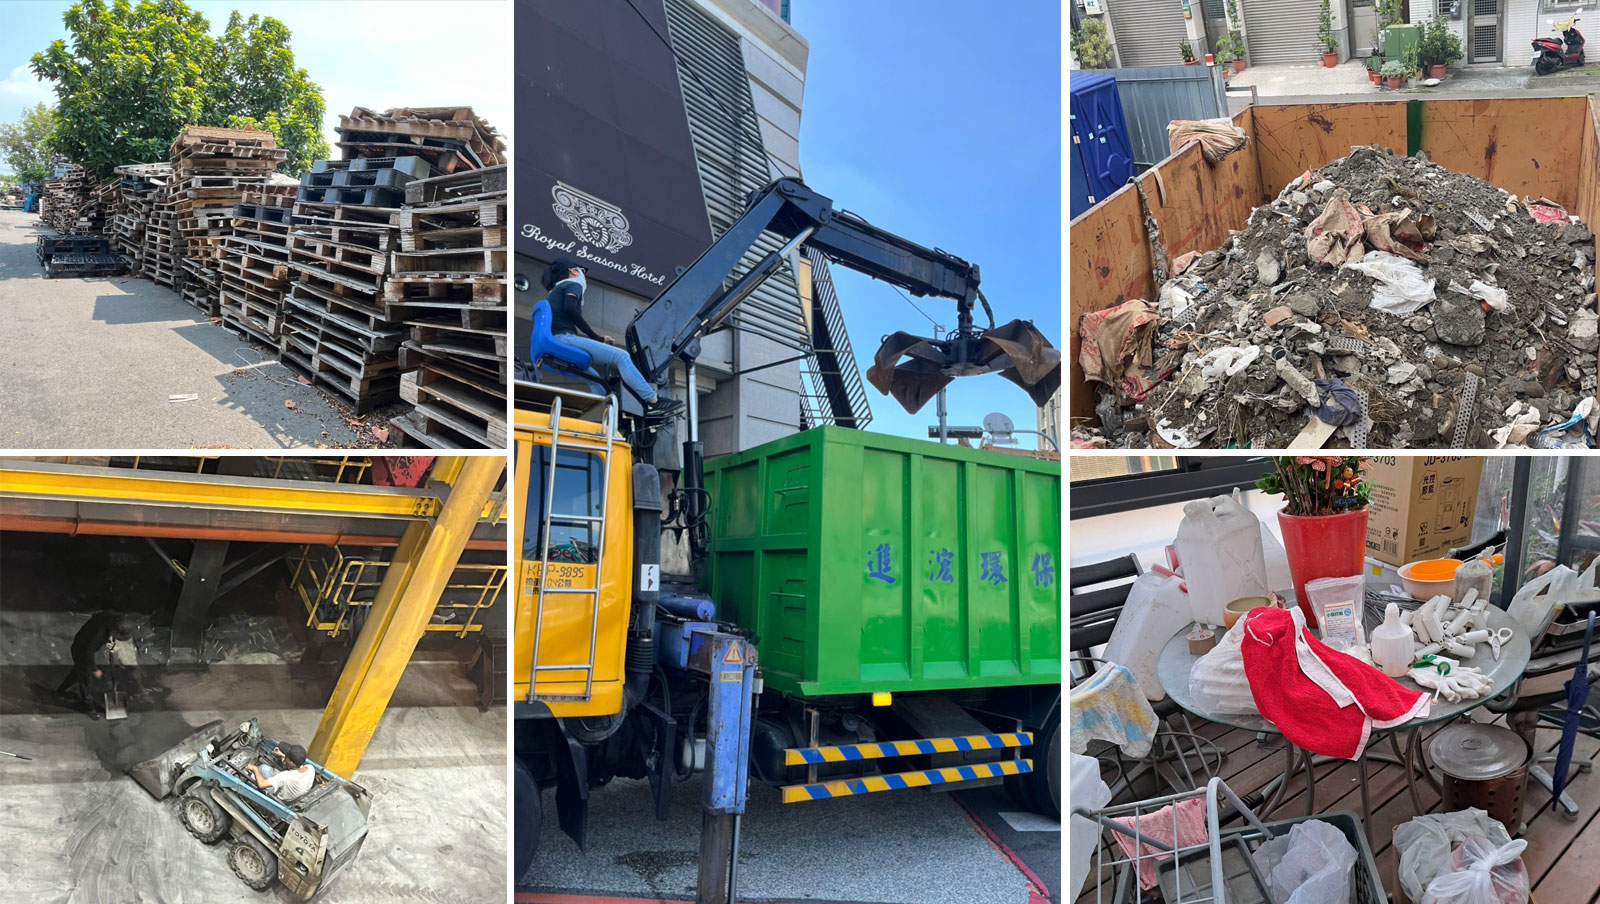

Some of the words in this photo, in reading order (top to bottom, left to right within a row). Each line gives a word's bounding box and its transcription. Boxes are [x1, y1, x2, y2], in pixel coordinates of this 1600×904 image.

[521, 224, 576, 253] Royal
[576, 246, 628, 273] Seasons
[630, 263, 666, 286] Hotel
[291, 827, 316, 852] TOYOTA
